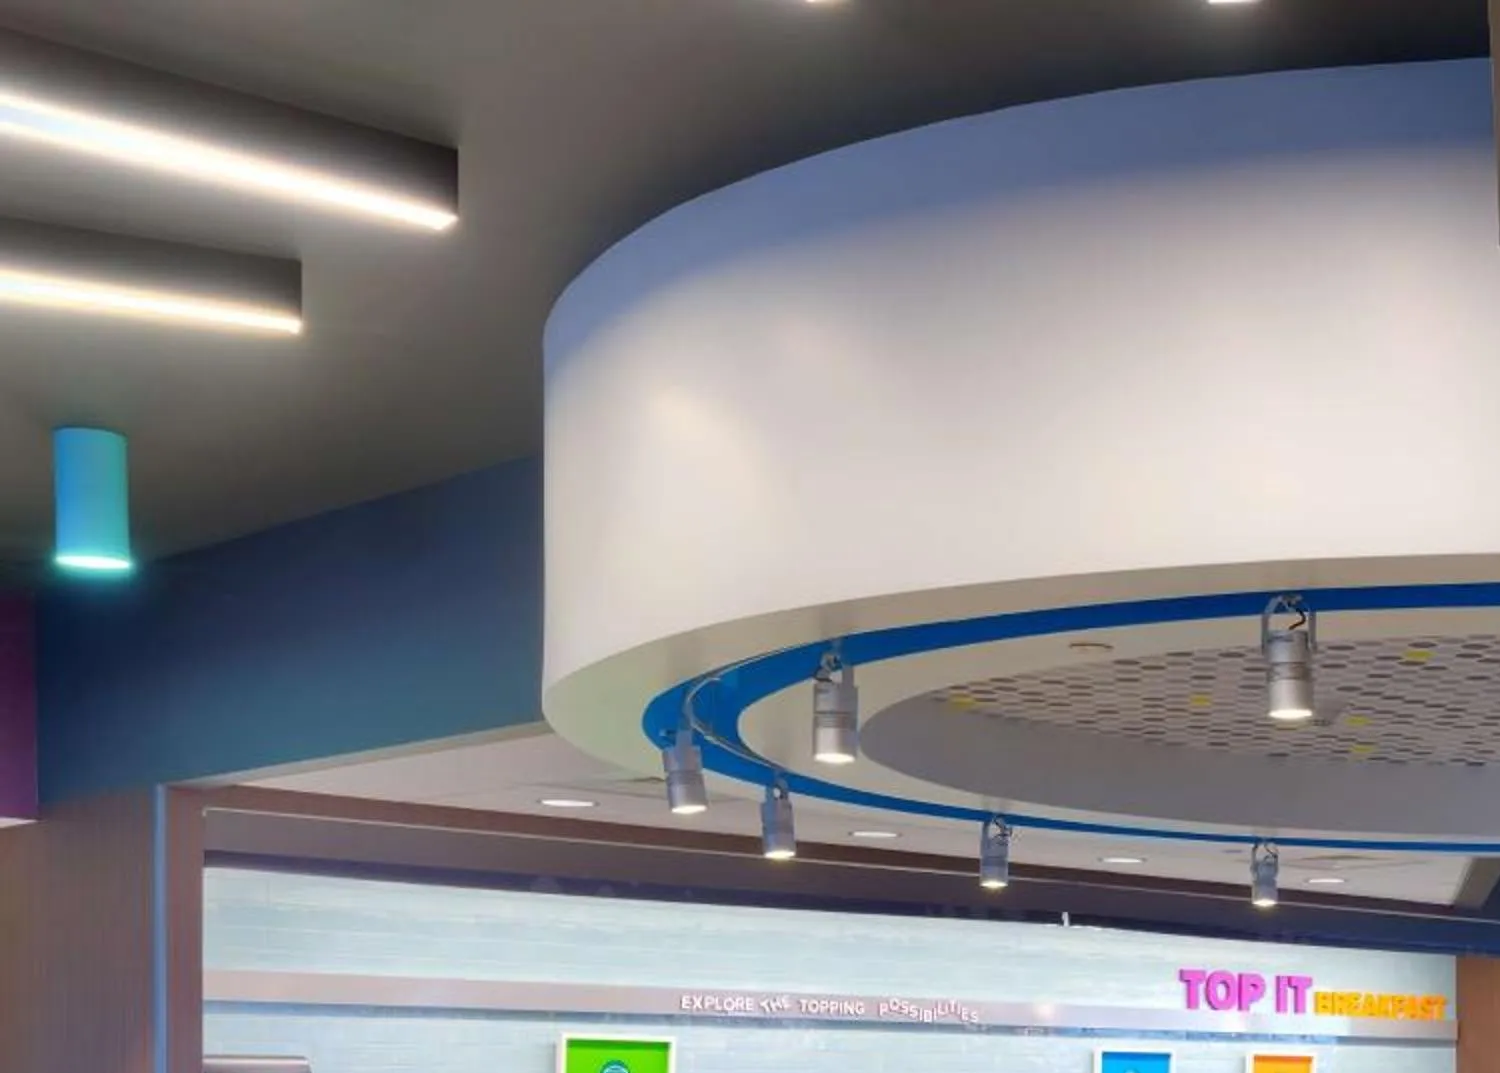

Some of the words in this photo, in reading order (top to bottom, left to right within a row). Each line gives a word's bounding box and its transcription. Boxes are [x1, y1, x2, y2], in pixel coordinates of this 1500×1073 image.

[681, 995, 754, 1012] EXPLORE
[760, 993, 790, 1012] THE
[799, 998, 865, 1016] TOPPING
[1178, 968, 1266, 1012] TOP
[1275, 975, 1314, 1014] IT
[1314, 991, 1447, 1021] BREAKFAST
